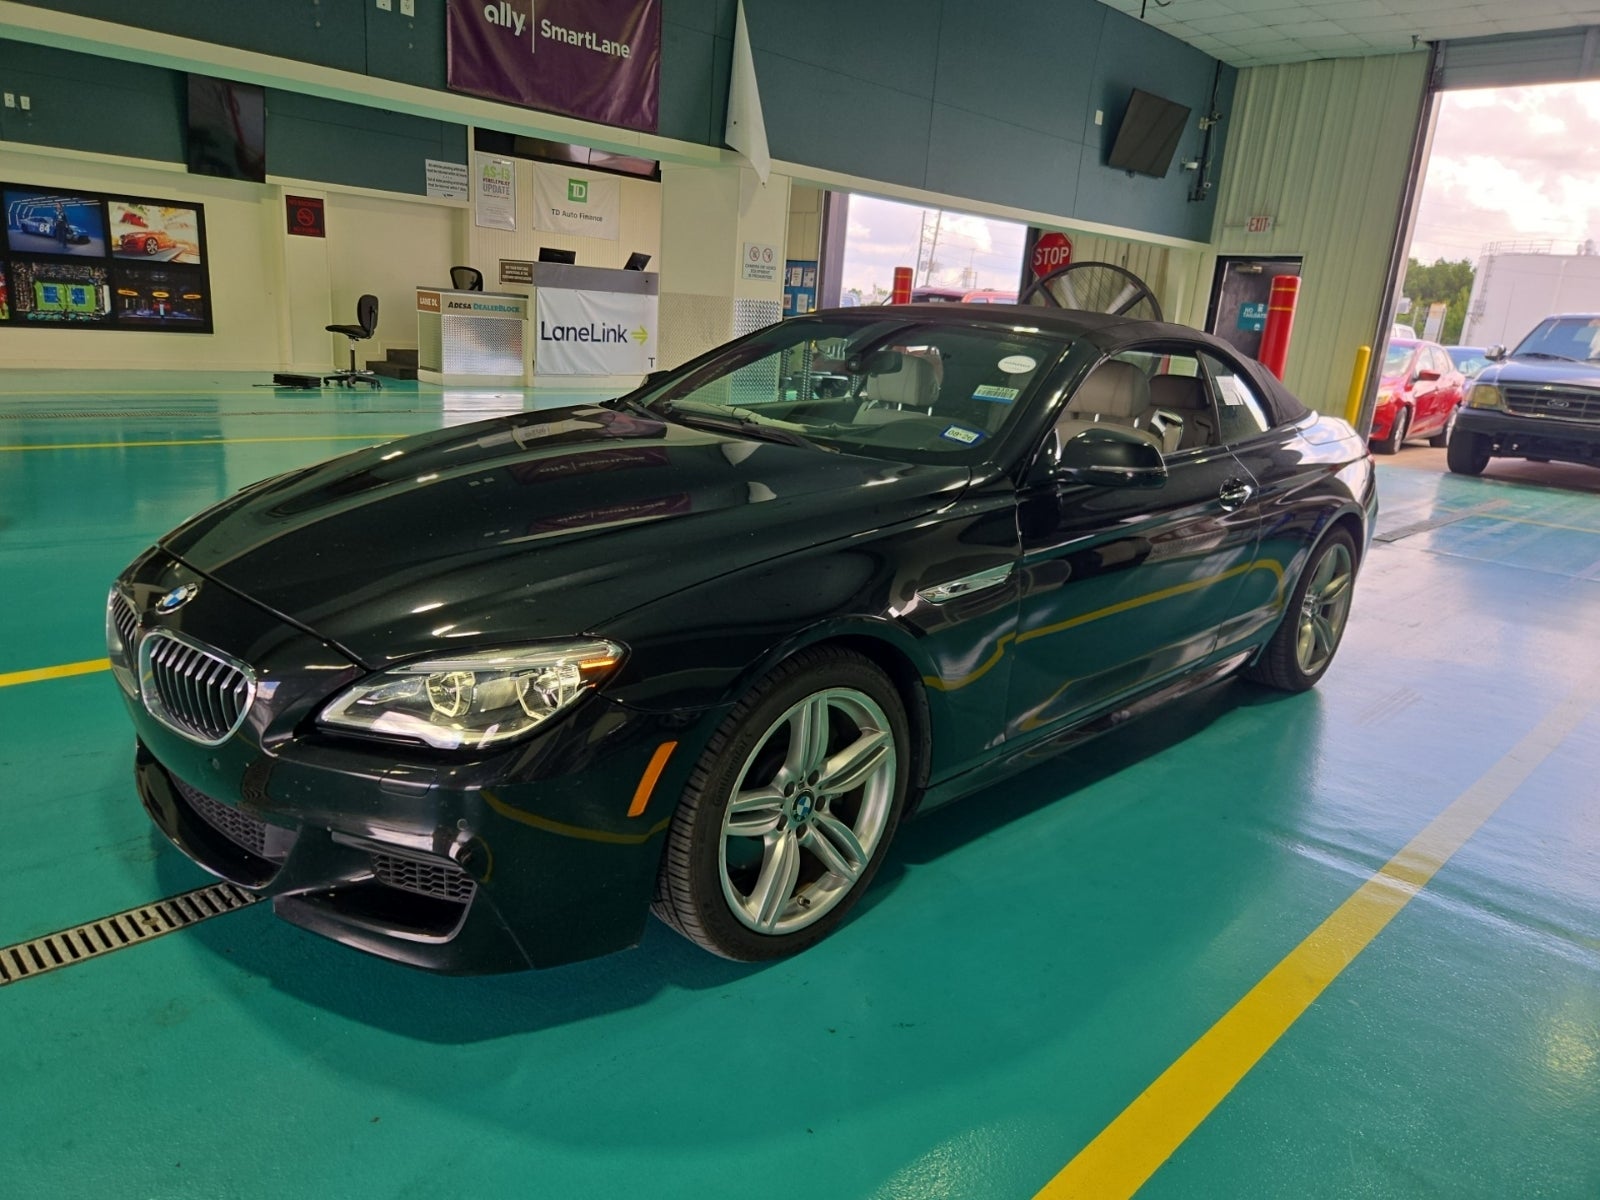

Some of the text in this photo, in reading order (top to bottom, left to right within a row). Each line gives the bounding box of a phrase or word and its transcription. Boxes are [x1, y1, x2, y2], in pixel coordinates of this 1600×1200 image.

[483, 1, 526, 37] ally
[541, 18, 631, 58] SmartLane
[482, 183, 511, 196] UPDATE
[570, 182, 586, 198] TD
[551, 208, 603, 222] TD Auto Finance
[1248, 217, 1269, 232] EXIT
[1033, 246, 1070, 266] STOP
[540, 321, 628, 343] LaneLink
[648, 357, 656, 368] T
